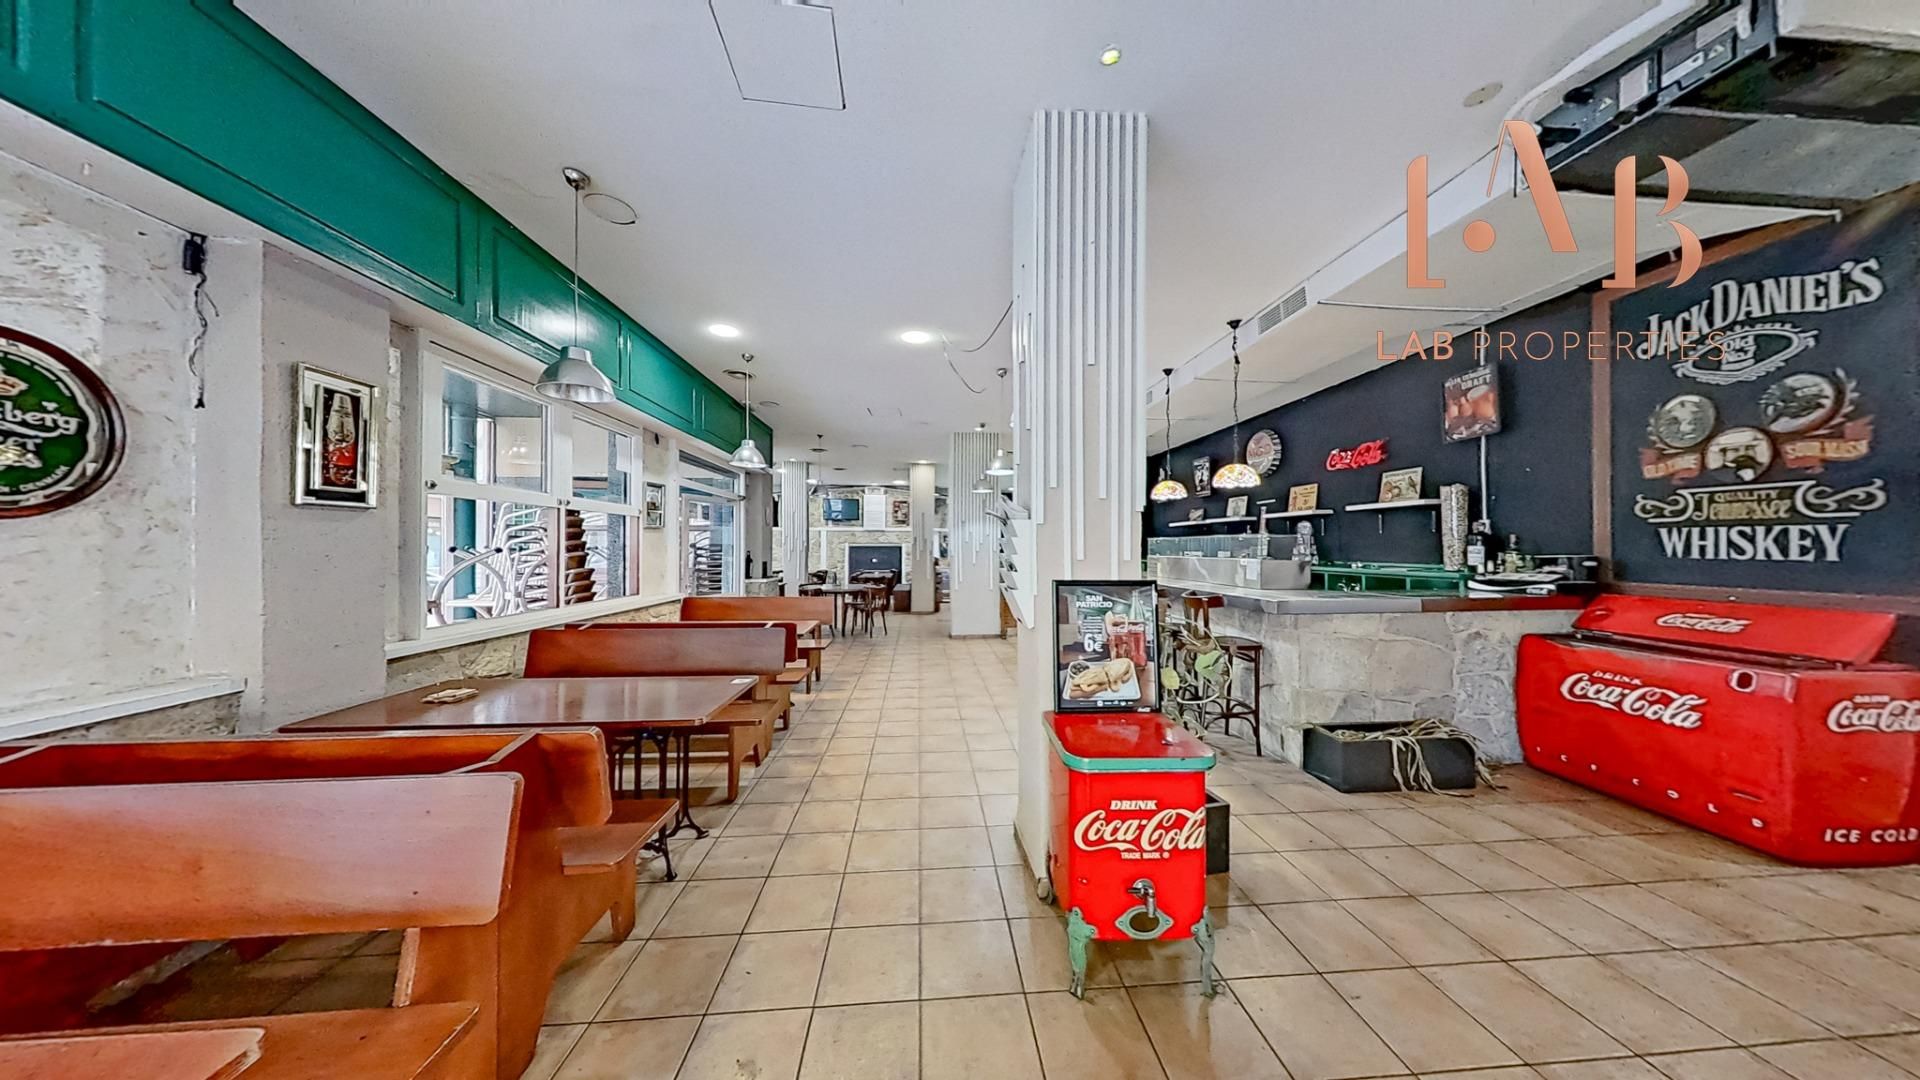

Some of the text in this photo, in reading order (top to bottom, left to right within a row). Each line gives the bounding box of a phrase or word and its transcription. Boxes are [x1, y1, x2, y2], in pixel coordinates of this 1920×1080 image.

[1636, 299, 1713, 360] JACK
[1702, 257, 1885, 331] DANIEL'S
[0, 399, 83, 436] berg
[1657, 523, 1851, 562] WHISKEY
[1075, 601, 1113, 609] PATRICIO
[1085, 594, 1103, 602] SAN
[1560, 673, 1708, 729] Coca-Cola
[1110, 800, 1158, 810] DRINK
[1074, 806, 1206, 851] Coca-Cola
[1824, 827, 1861, 843] ICE
[1120, 852, 1161, 860] TRADE MARK
